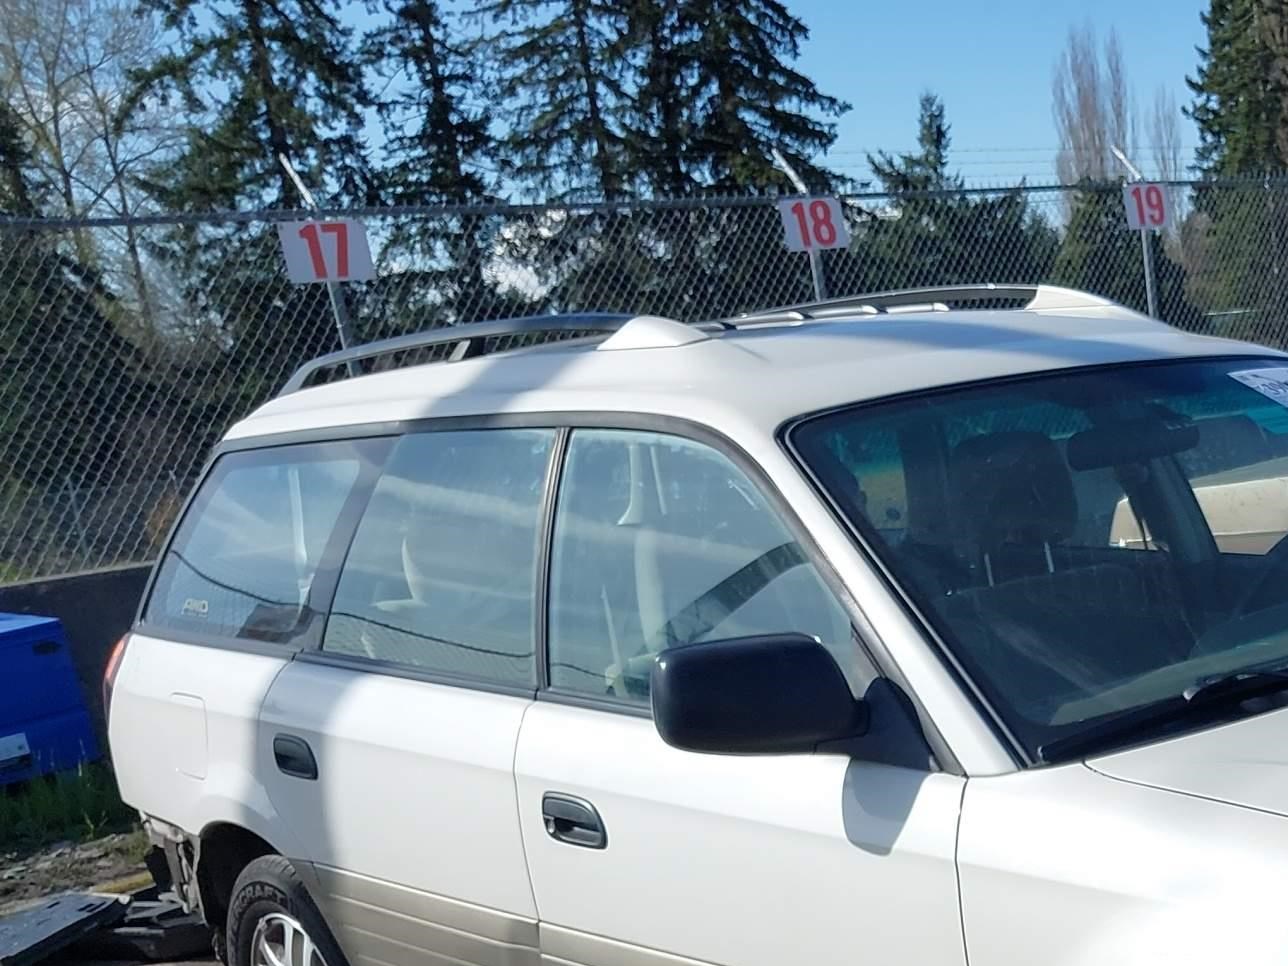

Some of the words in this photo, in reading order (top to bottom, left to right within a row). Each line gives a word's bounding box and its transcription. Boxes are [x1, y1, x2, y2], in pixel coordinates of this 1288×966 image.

[792, 200, 836, 248] 18
[1131, 186, 1164, 225] 19
[299, 223, 349, 279] 17
